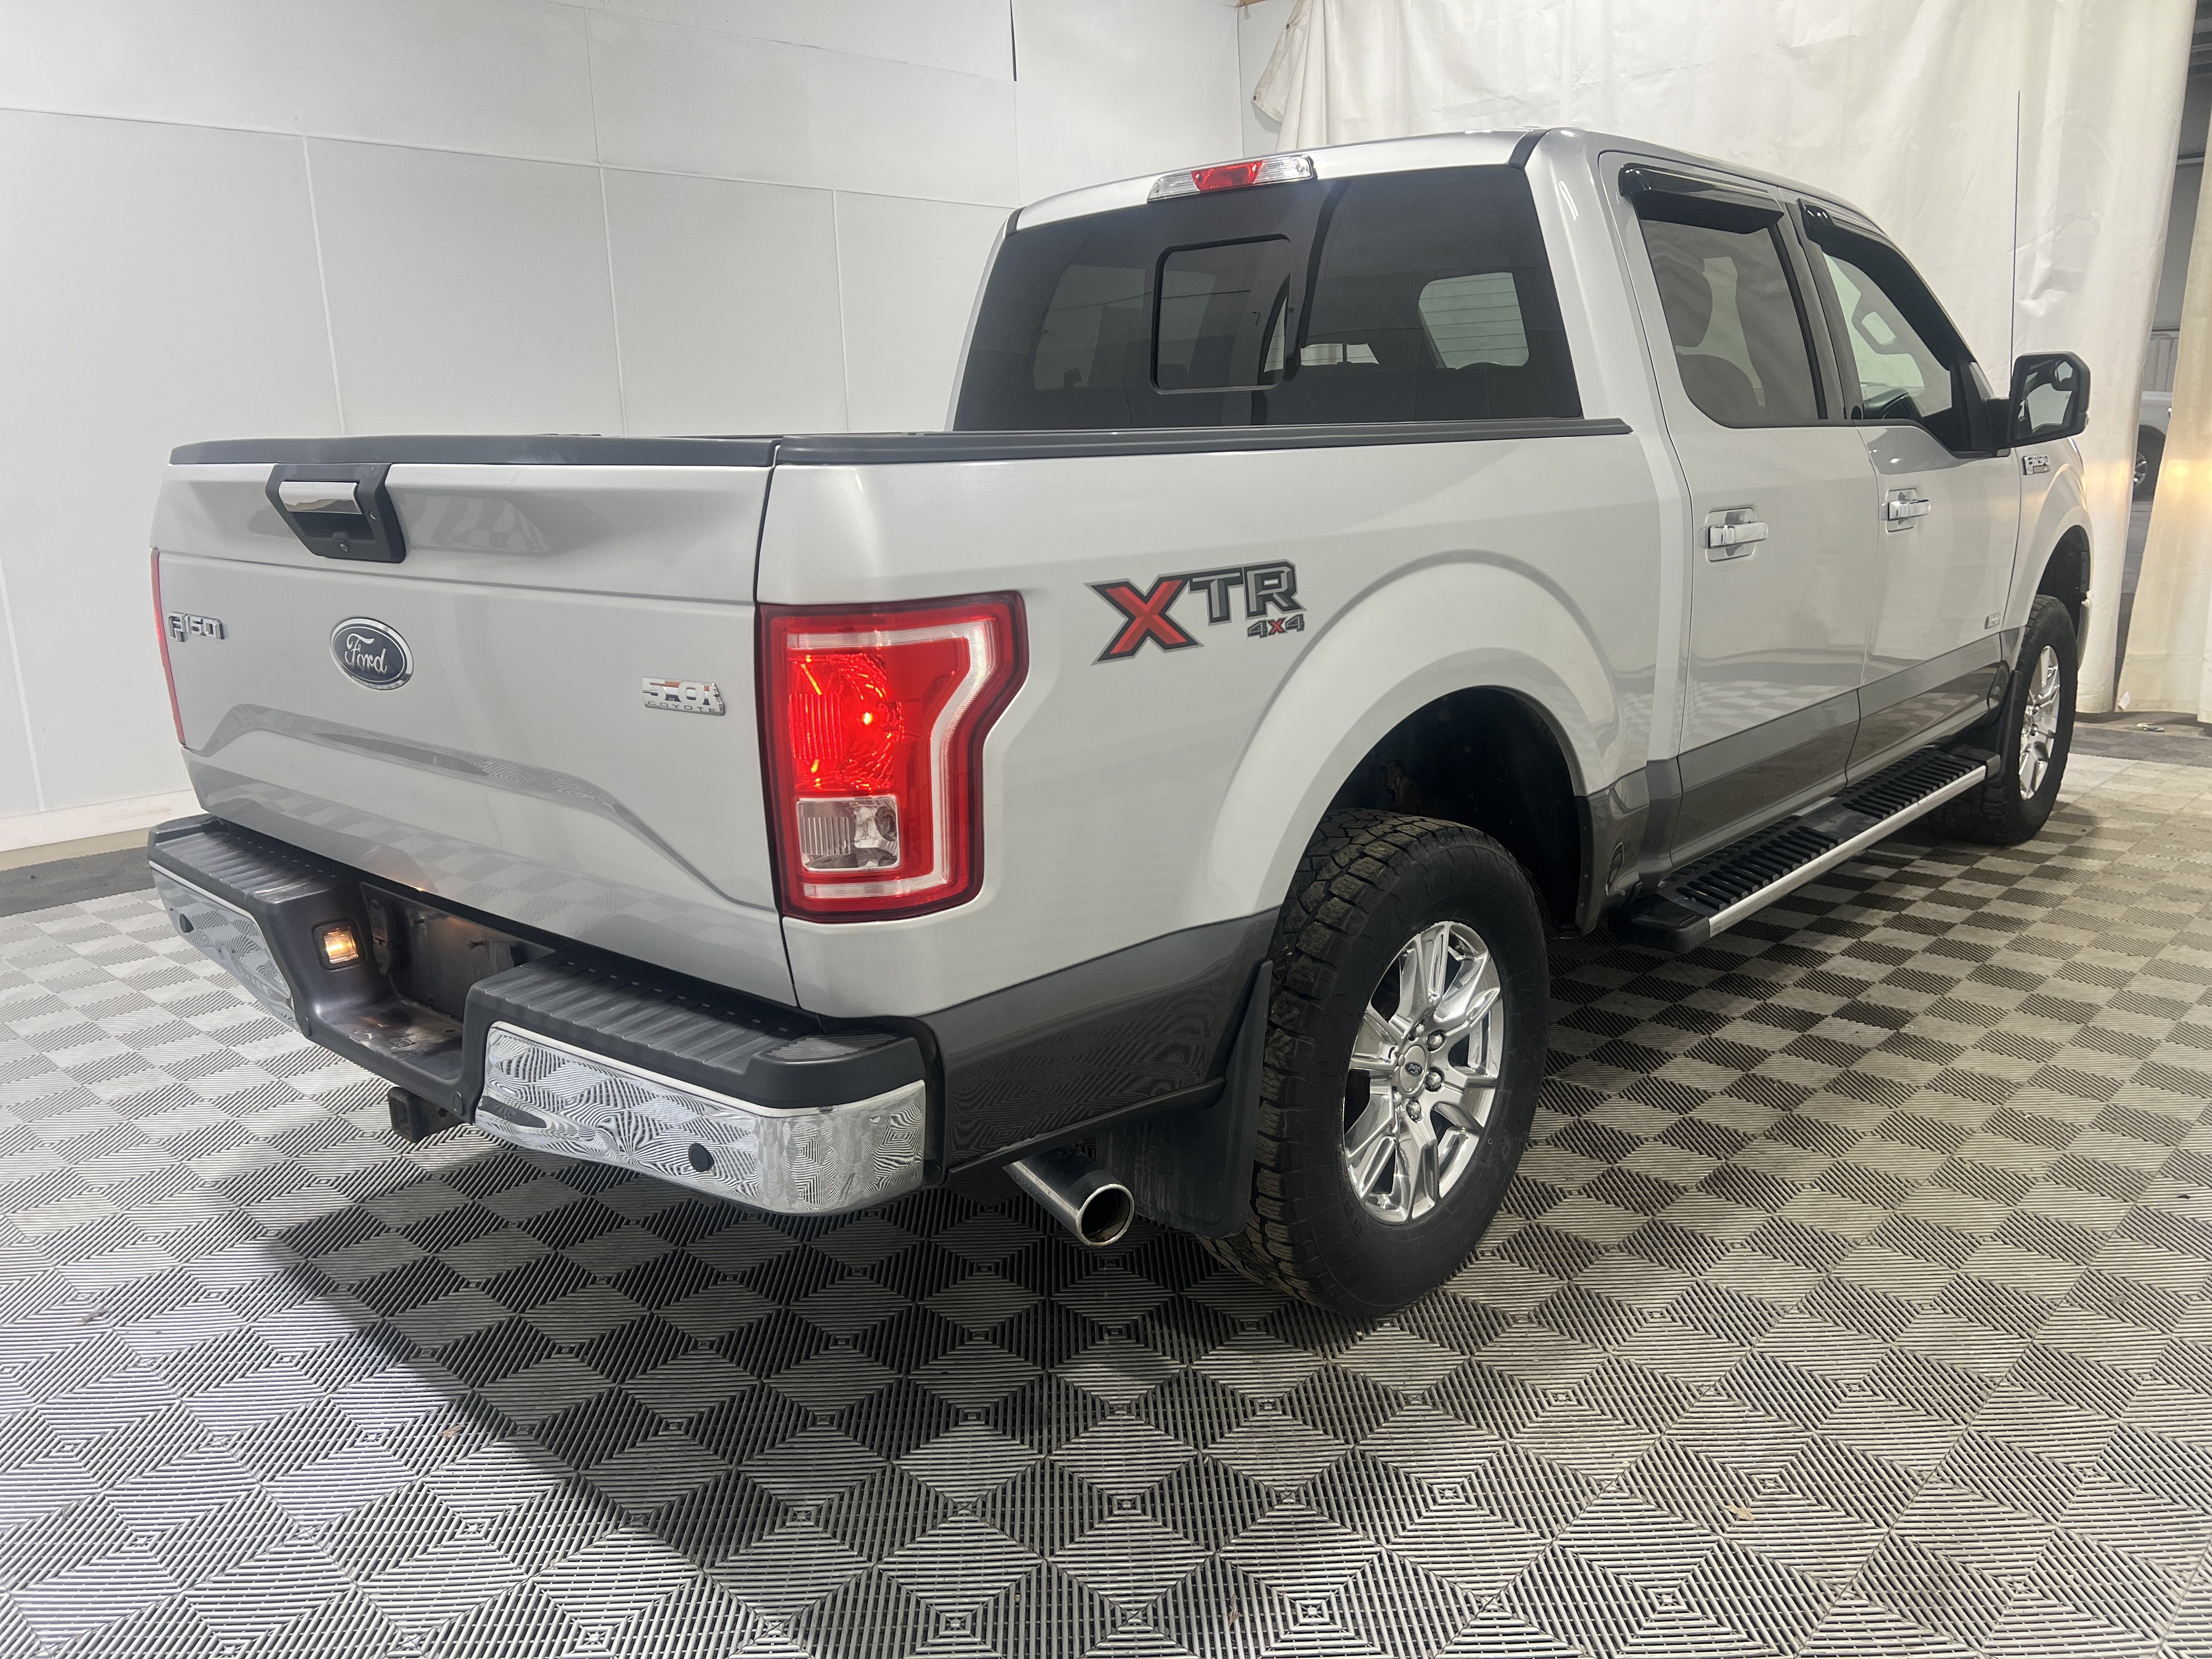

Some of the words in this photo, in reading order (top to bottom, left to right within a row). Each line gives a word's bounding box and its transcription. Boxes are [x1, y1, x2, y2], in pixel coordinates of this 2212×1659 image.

[1085, 559, 1306, 665] XTR
[344, 633, 387, 674] Ford
[647, 700, 716, 713] COYOTE
